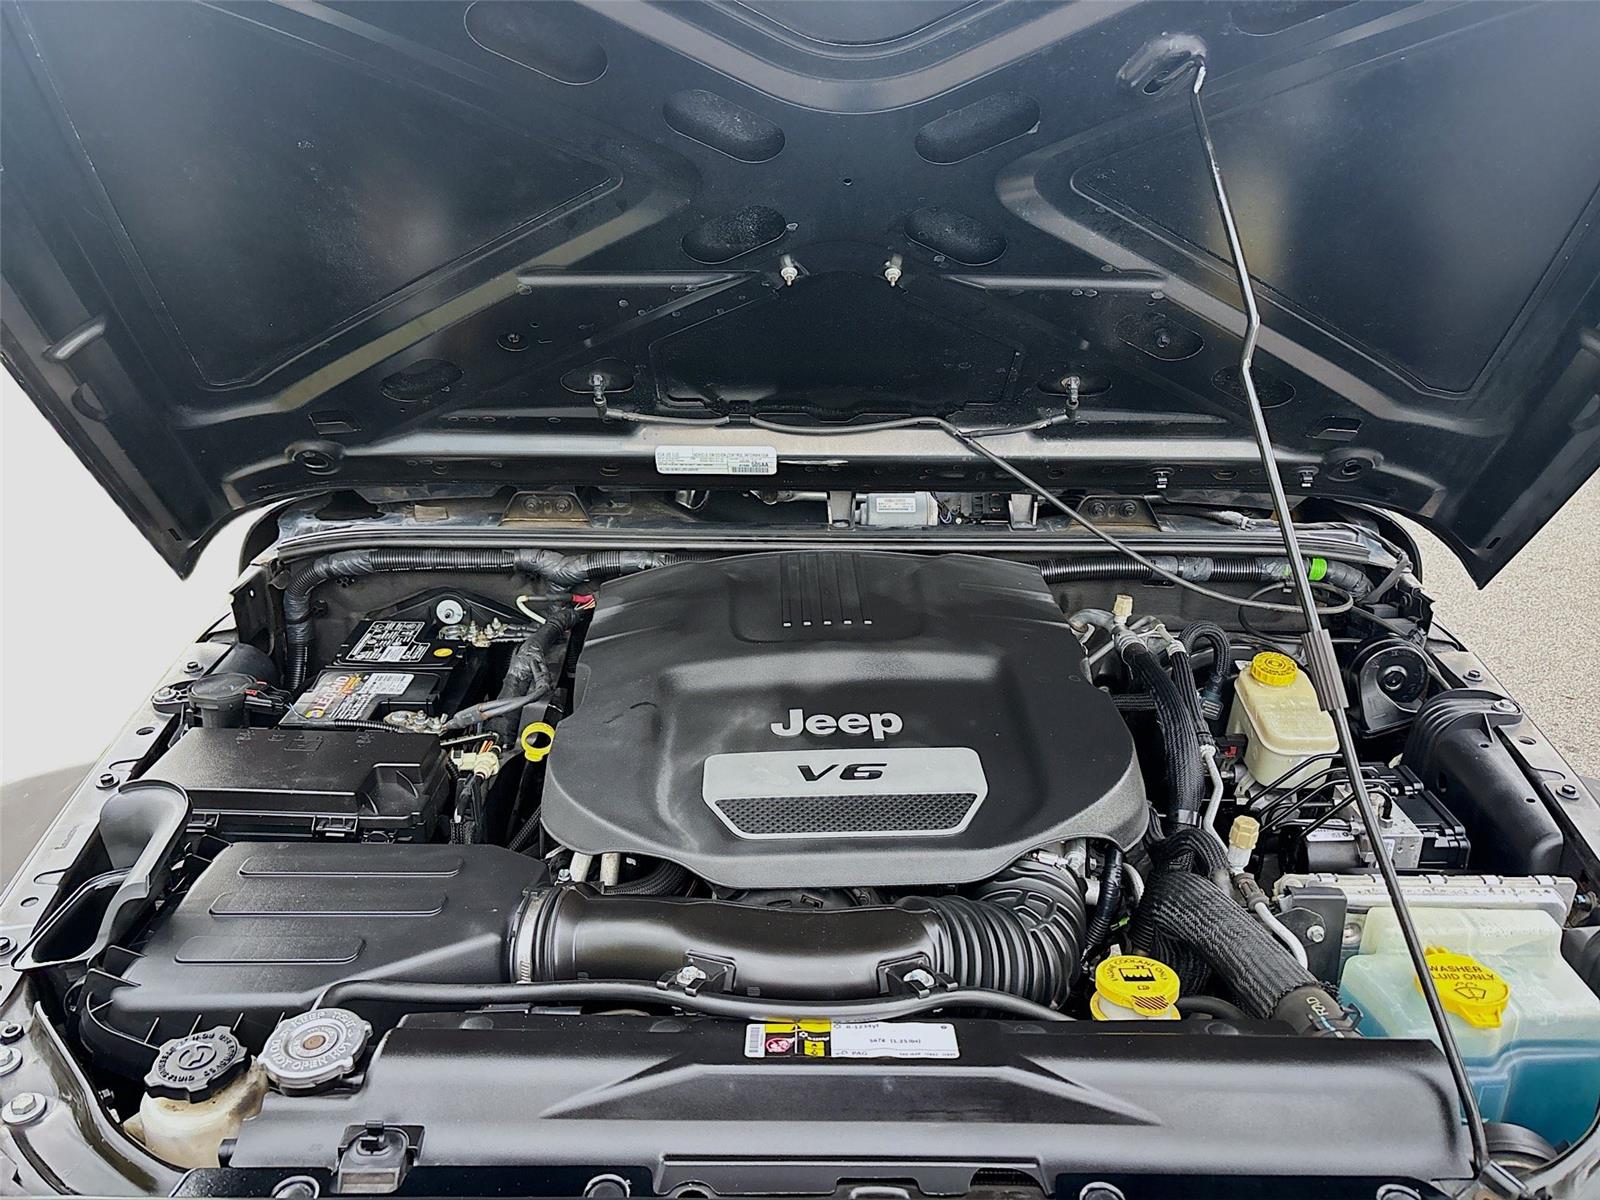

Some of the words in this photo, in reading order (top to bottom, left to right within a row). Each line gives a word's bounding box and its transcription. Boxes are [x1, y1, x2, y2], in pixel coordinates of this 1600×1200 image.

[770, 708, 903, 741] Jeep
[797, 763, 888, 782] V6
[1463, 973, 1495, 981] ONLY
[1306, 996, 1329, 1016] RAD
[292, 1011, 327, 1027] KEEP
[291, 1057, 328, 1071] OPEN
